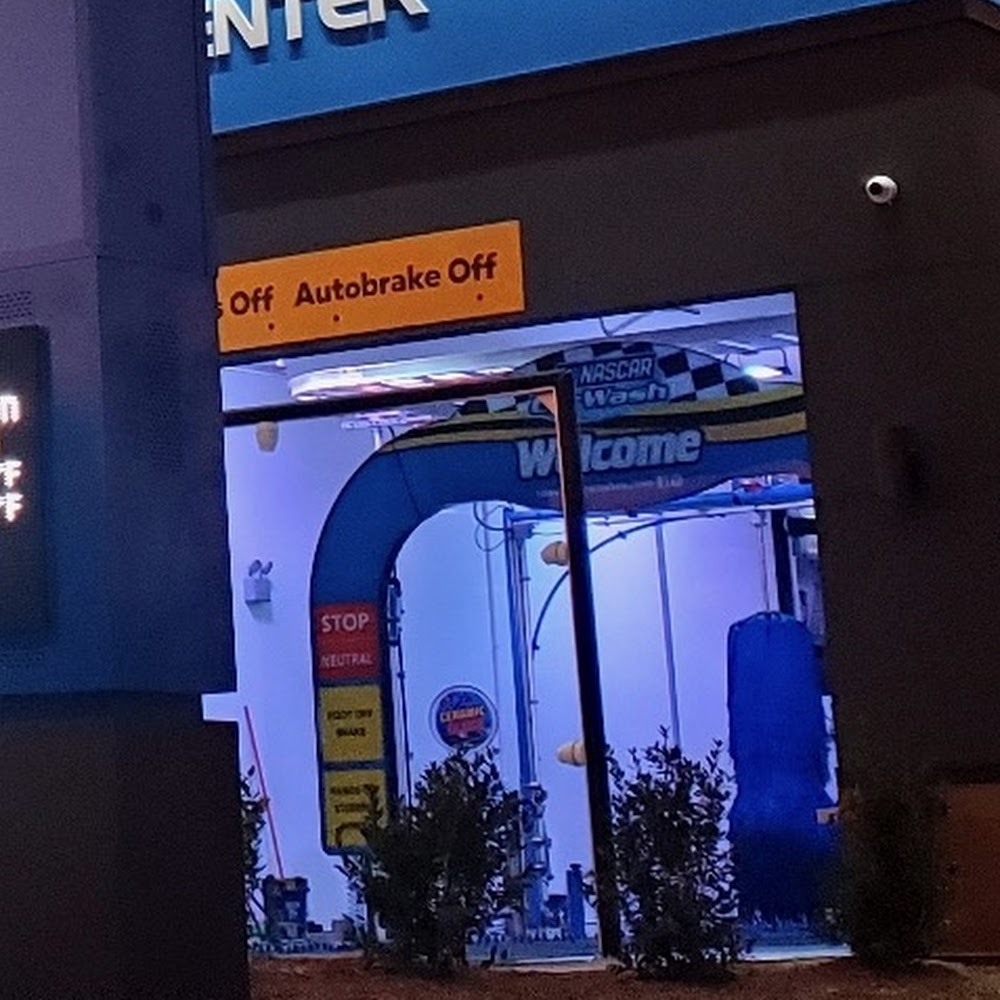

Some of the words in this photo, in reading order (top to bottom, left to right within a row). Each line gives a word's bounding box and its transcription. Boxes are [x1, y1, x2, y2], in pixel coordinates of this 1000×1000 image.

[230, 285, 274, 316] Off
[294, 265, 441, 307] Autobrake
[448, 252, 498, 284] Off
[579, 357, 653, 385] NASCAR
[517, 429, 702, 480] Wlcome
[321, 612, 370, 633] STOP
[320, 653, 374, 669] NEUTRAL
